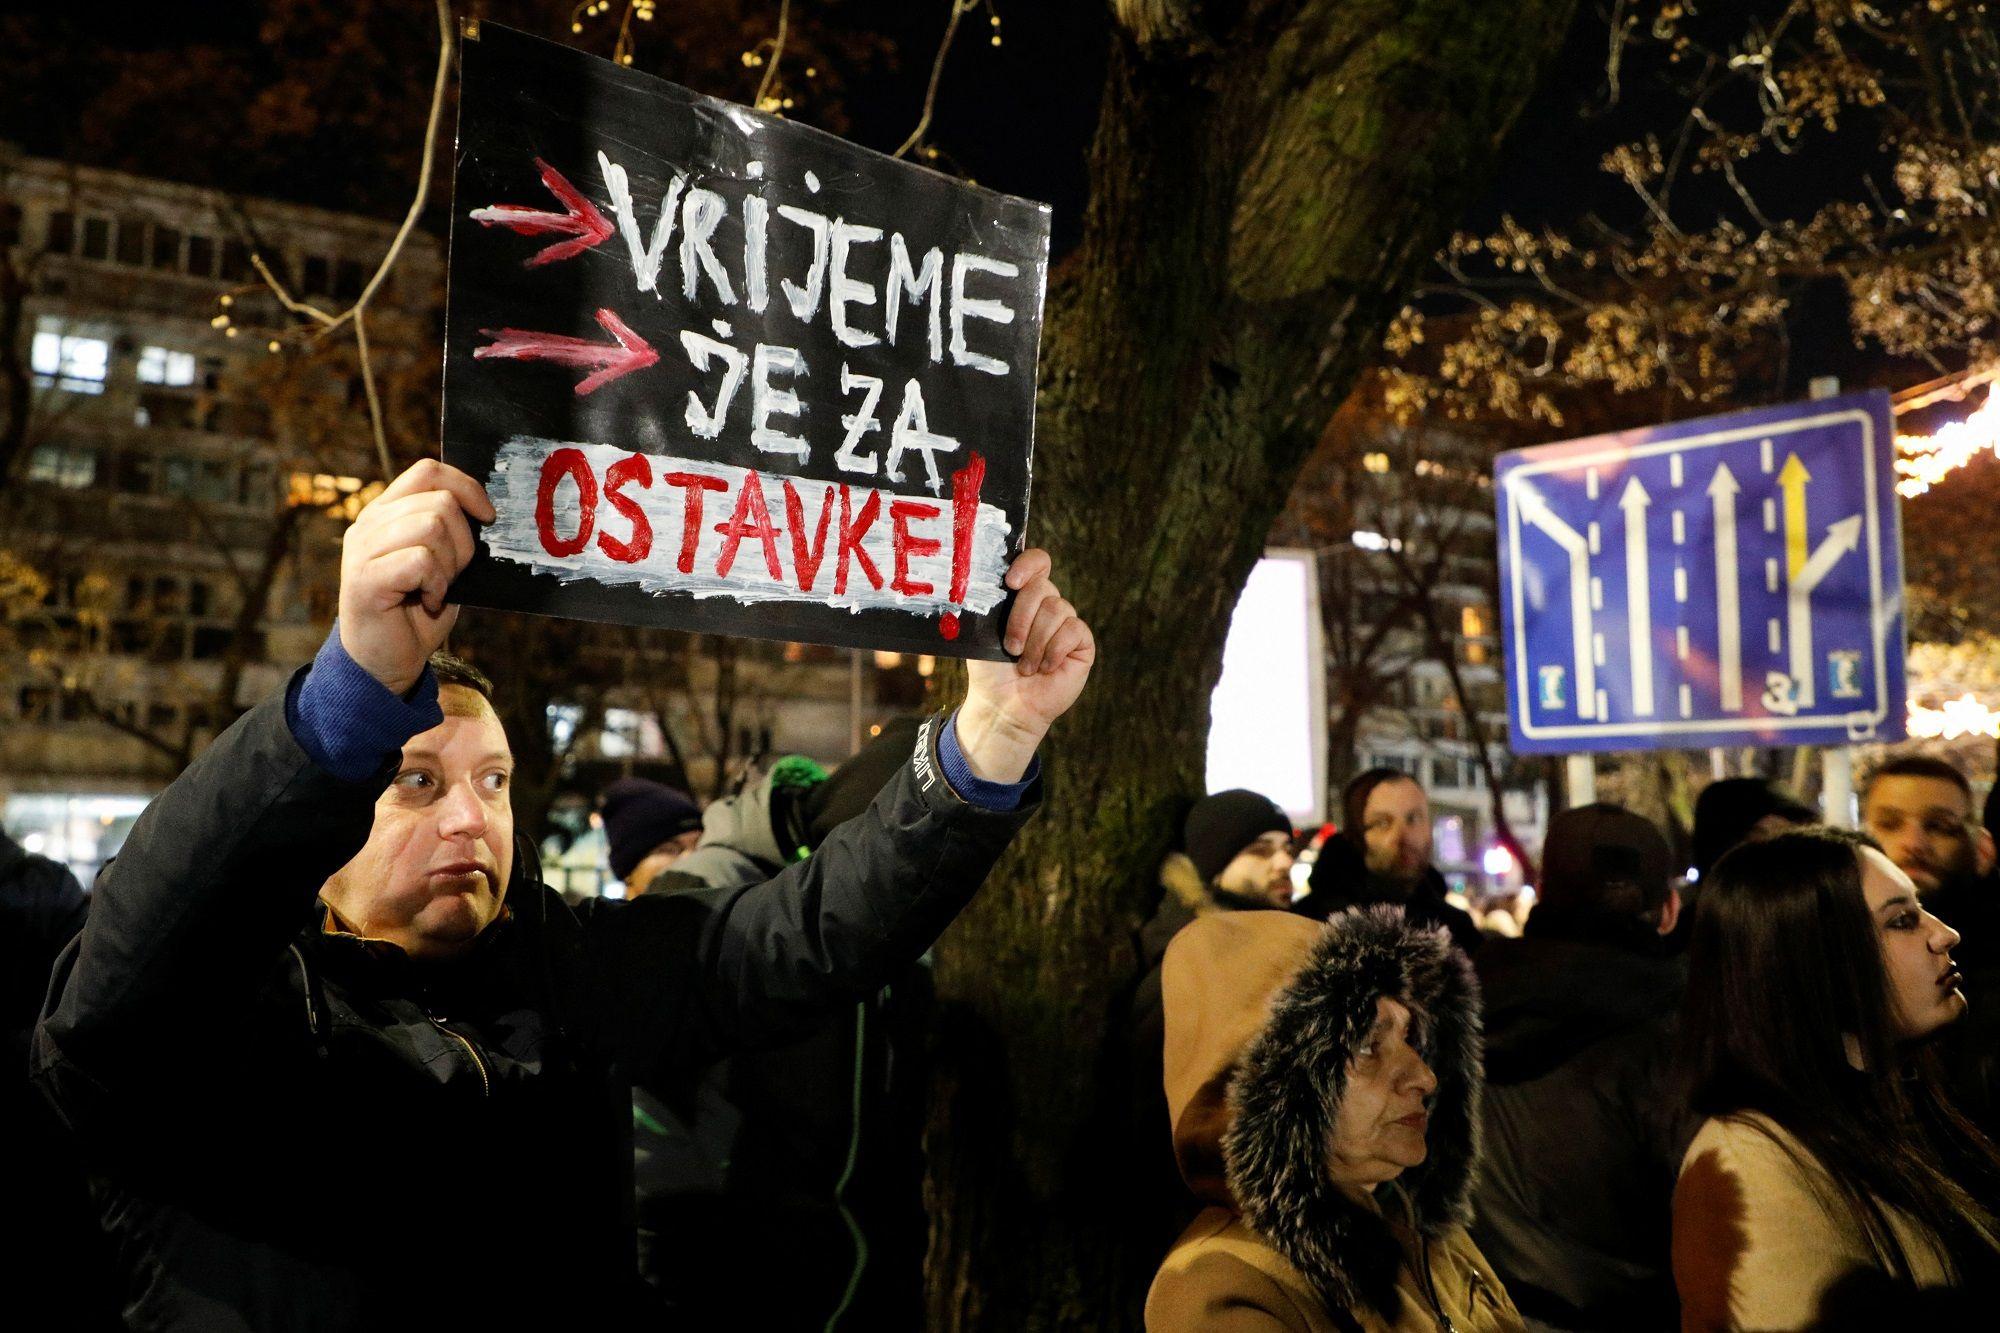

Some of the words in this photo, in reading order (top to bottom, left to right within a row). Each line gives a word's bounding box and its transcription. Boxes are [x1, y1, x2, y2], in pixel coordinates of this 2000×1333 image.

[598, 150, 1019, 375] VRIJEME
[680, 318, 811, 466] JE
[833, 362, 961, 498] ZA
[535, 448, 986, 641] OSTAVKE!
